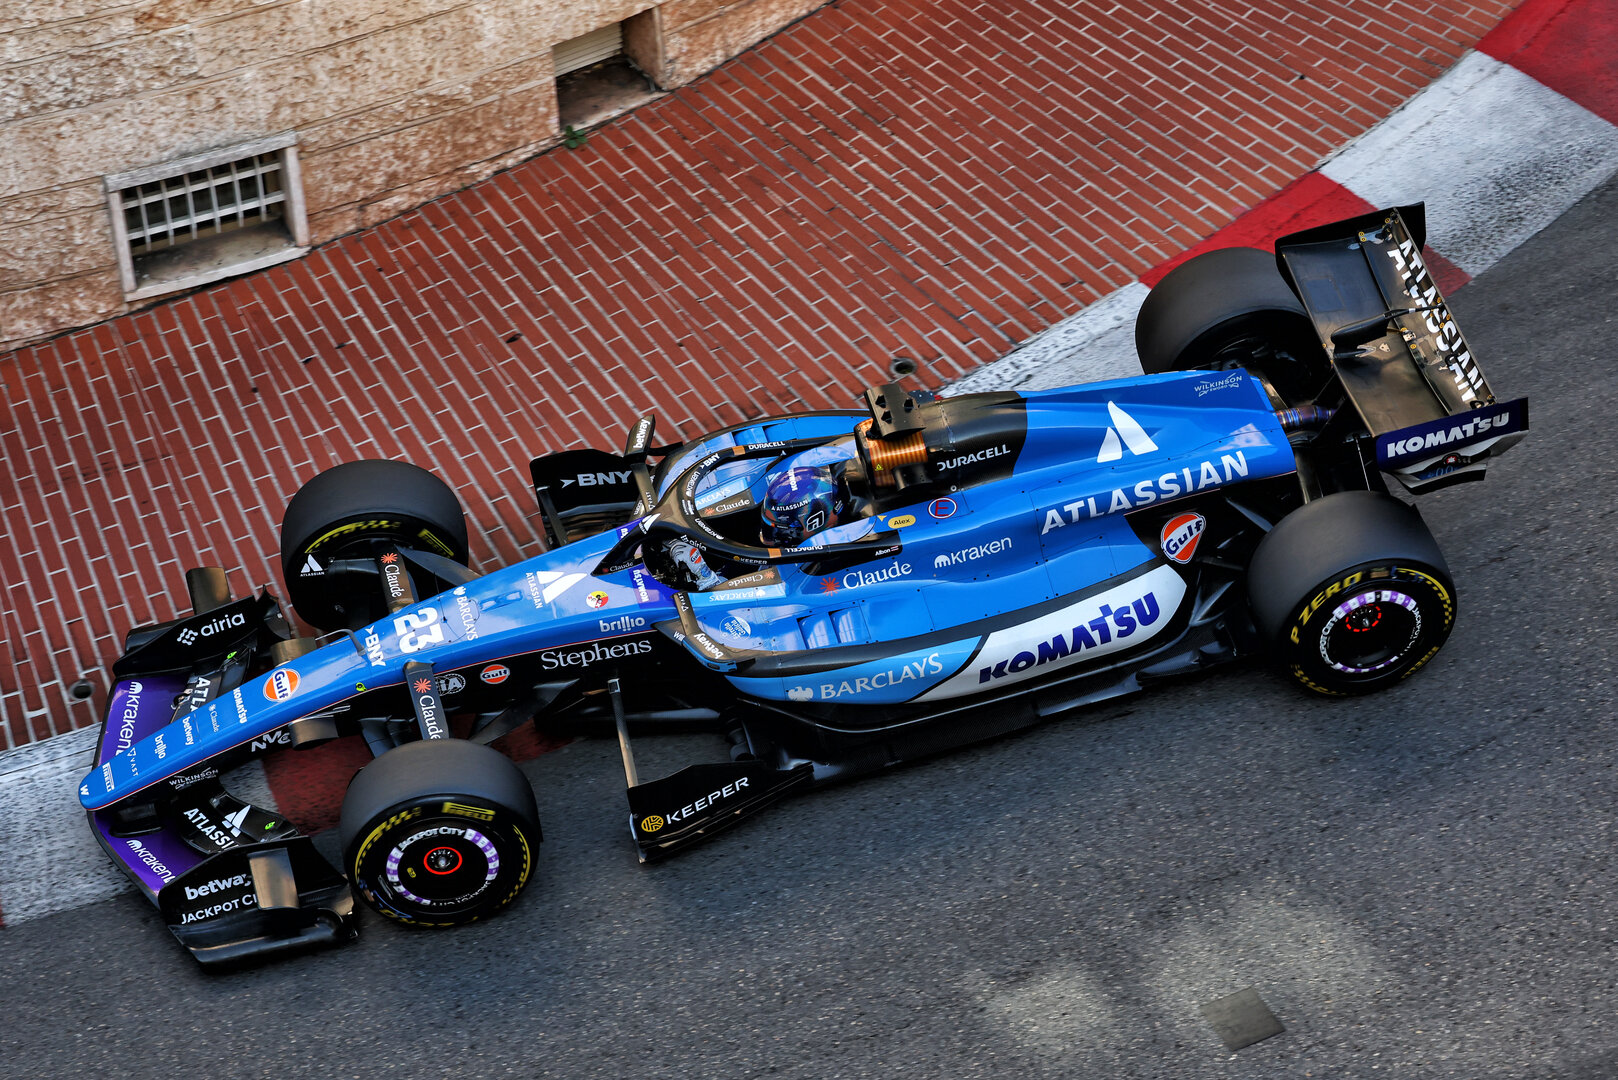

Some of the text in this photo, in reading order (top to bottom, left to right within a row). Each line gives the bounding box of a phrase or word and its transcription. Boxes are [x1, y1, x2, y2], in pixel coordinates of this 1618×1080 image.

[1194, 376, 1242, 391] WILKINSON
[633, 419, 650, 449] betway
[748, 441, 785, 450] DURACELL
[1387, 412, 1510, 458] KOMATSU
[703, 453, 720, 467] BNY
[936, 444, 1011, 471] DURACELL
[577, 470, 632, 487] BNY
[1041, 450, 1249, 535] ATLASSIAN
[716, 499, 750, 512] Claude
[776, 499, 809, 511] ATLASSIAN
[934, 499, 949, 517] E
[1165, 517, 1203, 555] Gulf
[875, 548, 891, 556] Albon
[950, 537, 1012, 565] kraken
[609, 561, 634, 572] Claude
[728, 574, 764, 587] Claude
[843, 560, 912, 590] Claude
[384, 564, 404, 598] Claude
[526, 572, 543, 609] ATLASSIAN
[709, 591, 754, 602] BARCLAYS
[1290, 571, 1363, 645] P ZERO
[200, 612, 246, 638] airia
[393, 606, 445, 654] 23
[456, 595, 479, 641] BARCLAYS
[599, 616, 646, 632] brillio
[365, 633, 386, 667] BNY
[694, 632, 724, 659] betway
[978, 592, 1160, 684] KOMATSU
[541, 639, 652, 670] Stephens
[274, 671, 289, 699] Gulf
[482, 669, 508, 679] Gulf
[821, 652, 943, 700] BARCLAYS
[232, 687, 248, 724] KOMATSU
[117, 695, 141, 749] kraken
[182, 716, 194, 746] betway
[102, 762, 115, 793] PIRELLI
[130, 757, 139, 777] VAST
[169, 769, 219, 786] WILKINSON
[442, 802, 496, 821] PIRELLI
[666, 776, 749, 825] KEEPER
[183, 808, 239, 850] ATLASSI
[439, 826, 465, 836] CITY
[136, 846, 172, 880] kraken
[181, 899, 240, 925] JACKPOT
